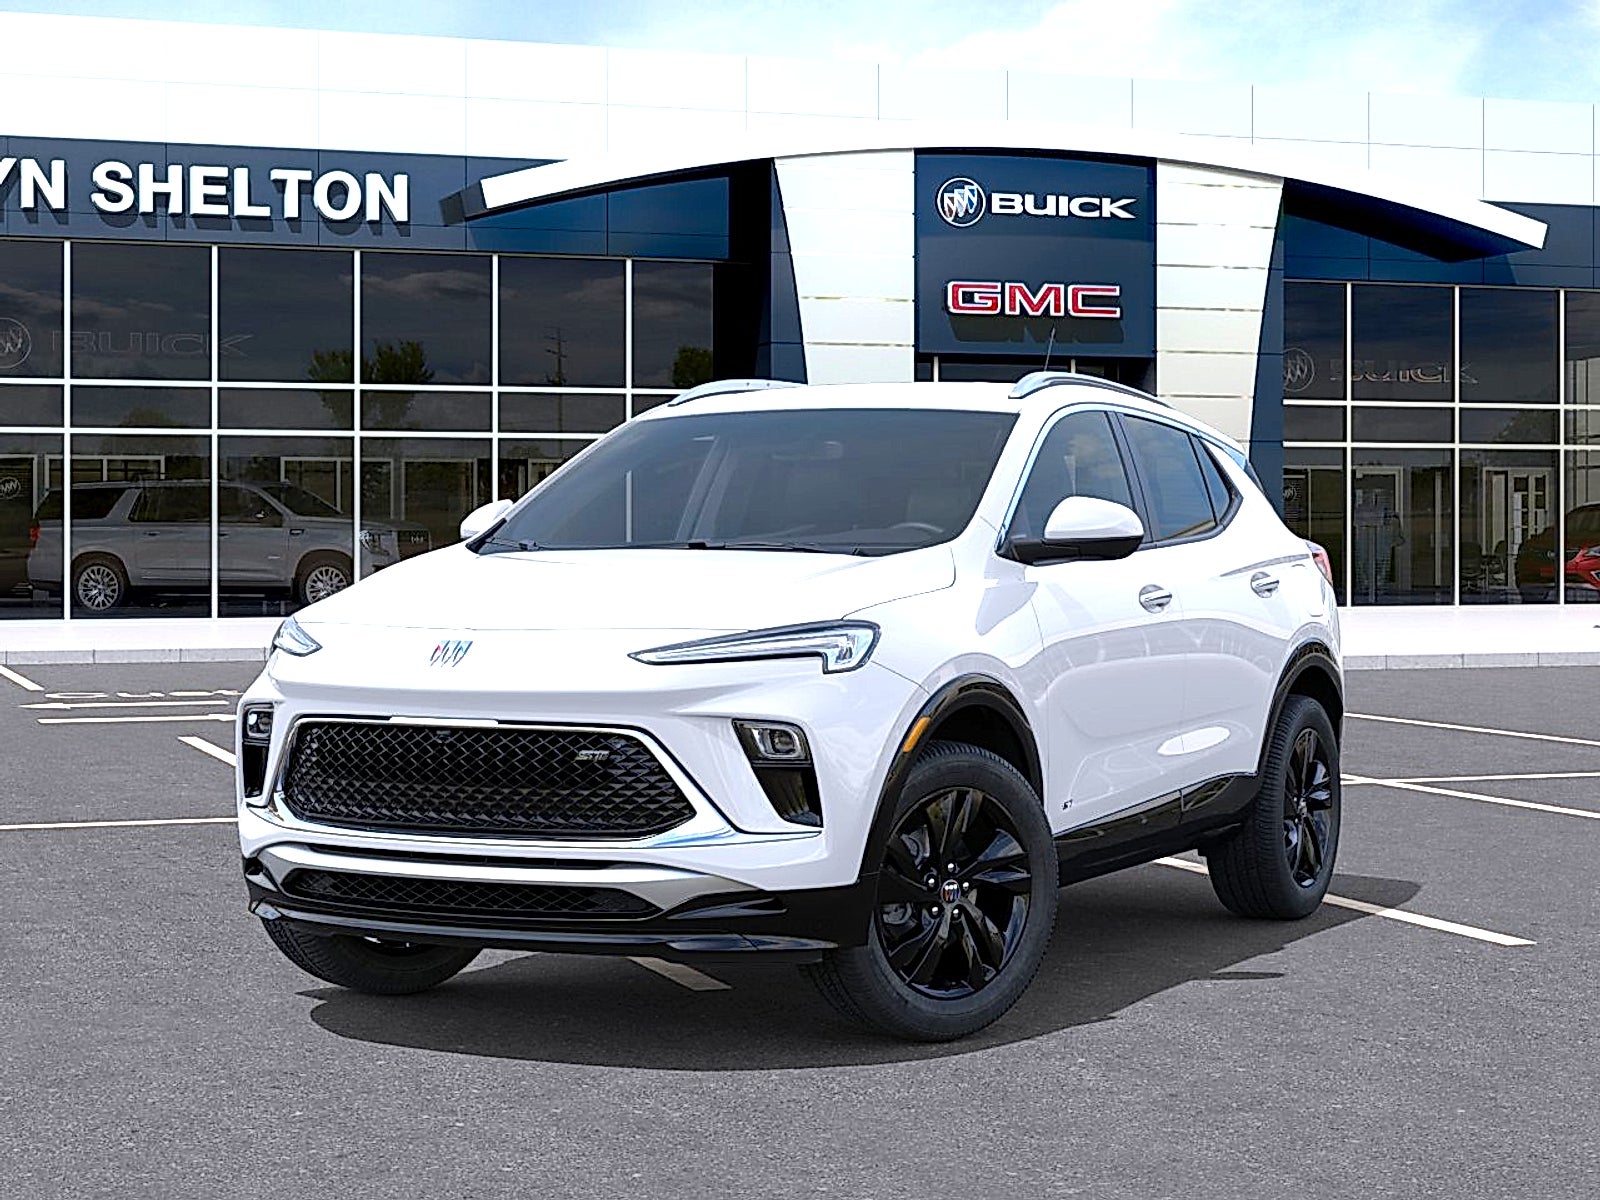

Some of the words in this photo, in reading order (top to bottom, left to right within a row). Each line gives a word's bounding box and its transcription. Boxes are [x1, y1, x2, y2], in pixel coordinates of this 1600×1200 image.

[90, 160, 409, 222] SHELTON
[990, 192, 1137, 219] BUICK
[947, 281, 1121, 318] GMC
